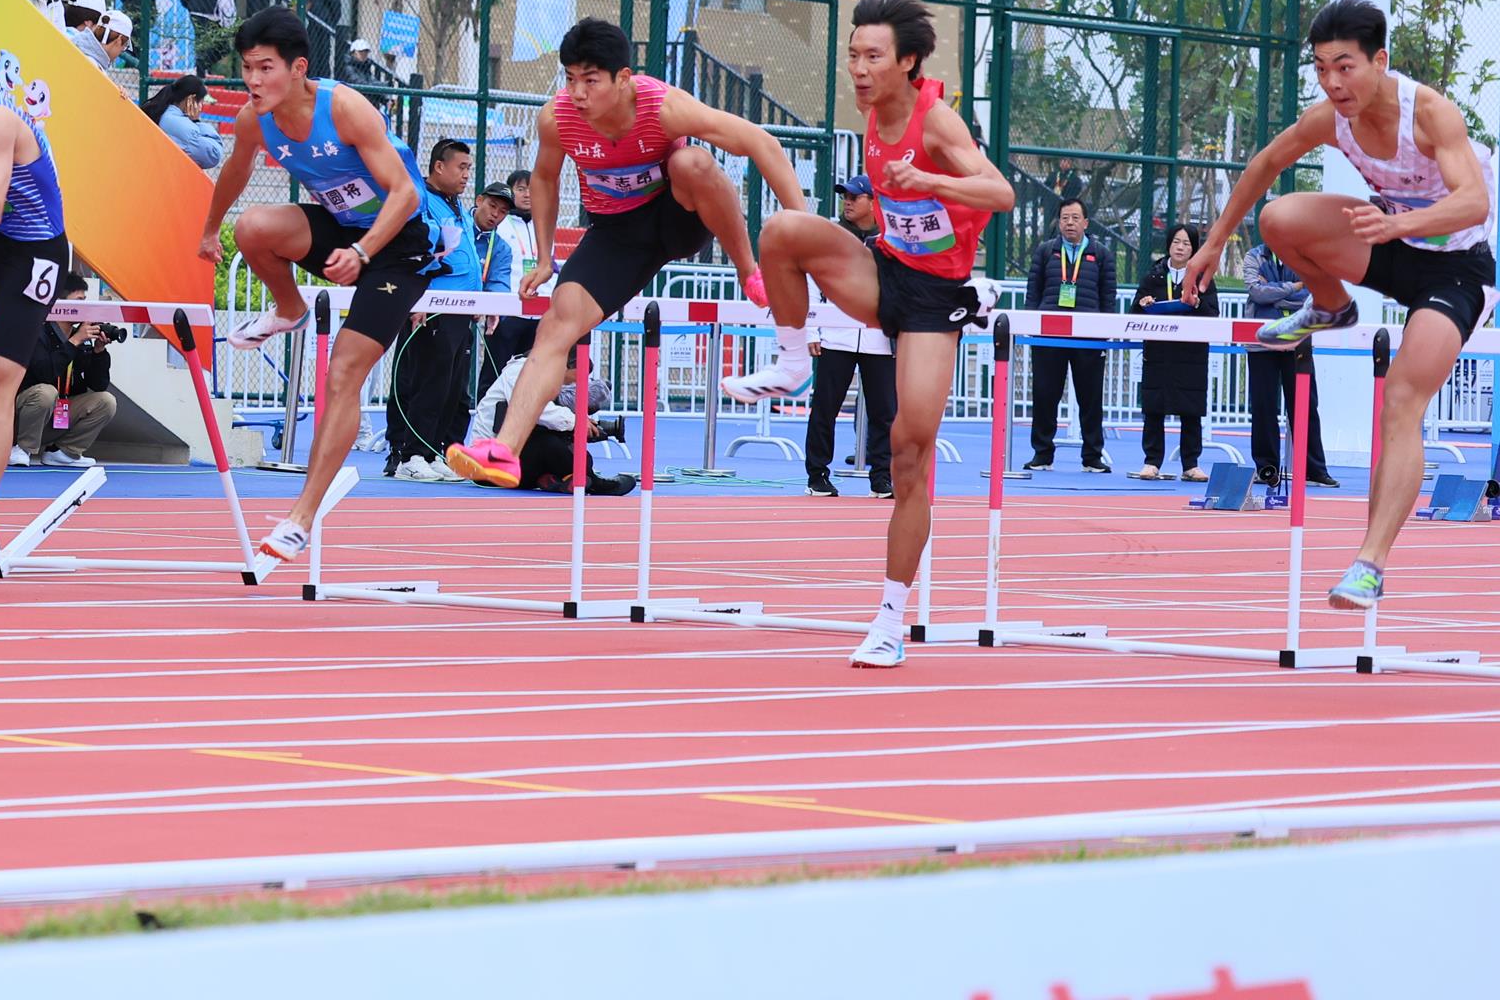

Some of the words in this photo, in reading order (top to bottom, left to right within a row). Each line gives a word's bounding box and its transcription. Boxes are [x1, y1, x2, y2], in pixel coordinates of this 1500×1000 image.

[311, 140, 339, 158] 上海
[574, 142, 605, 158] 山东
[35, 265, 53, 300] 6
